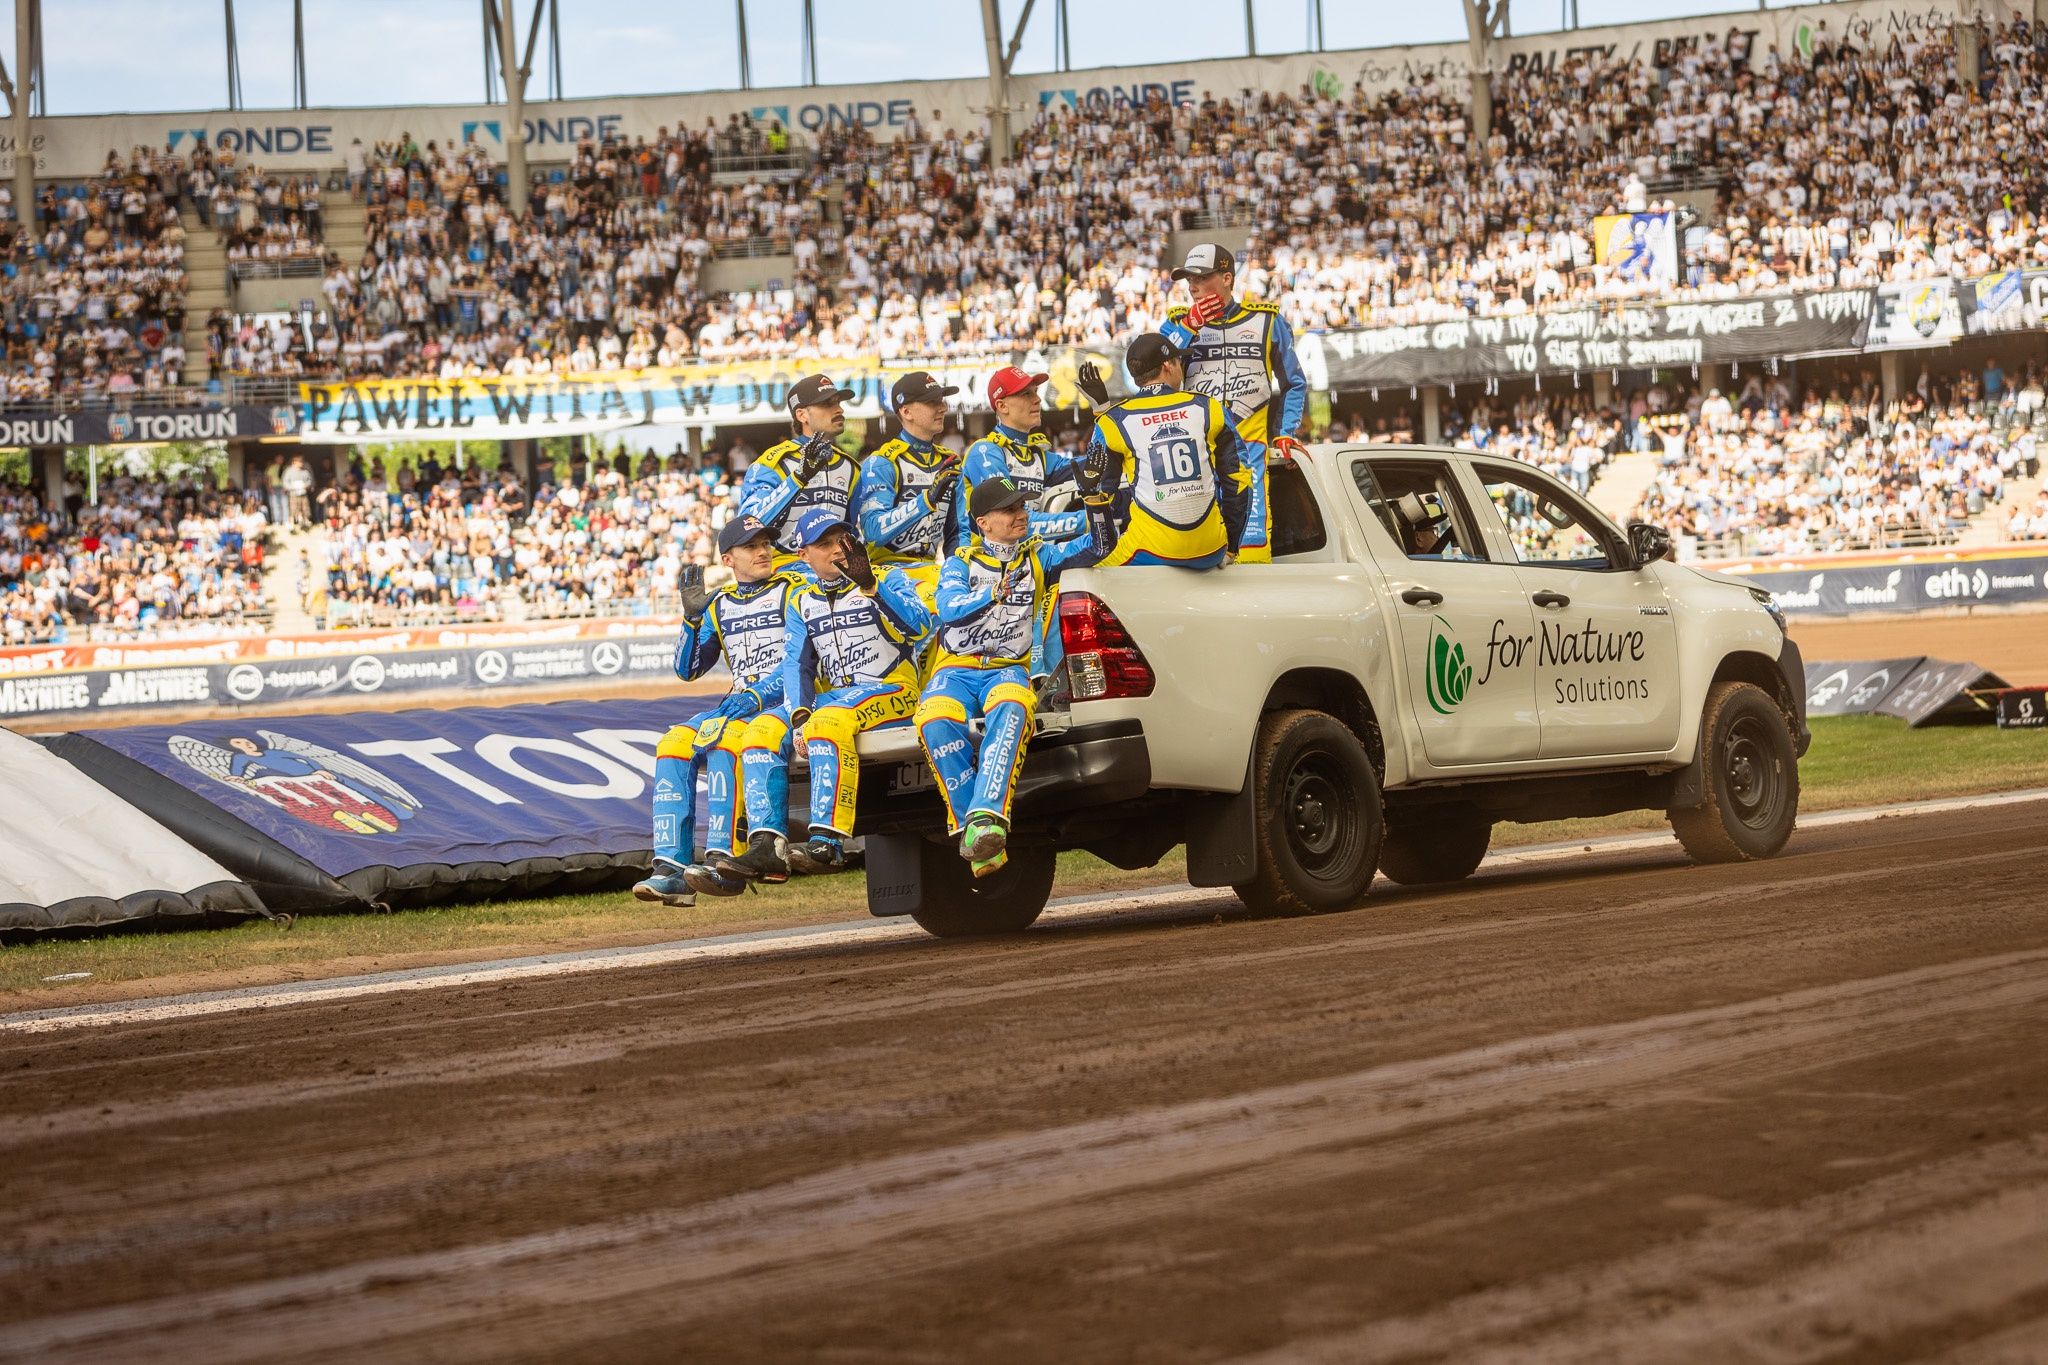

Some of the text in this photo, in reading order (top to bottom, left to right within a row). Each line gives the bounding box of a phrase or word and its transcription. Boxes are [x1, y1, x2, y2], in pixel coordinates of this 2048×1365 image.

[1085, 81, 1196, 110] ONDE
[799, 101, 914, 128] ONDE
[216, 126, 332, 154] ONDE
[135, 407, 238, 440] TORUŃ
[1142, 411, 1189, 426] DEREK
[1155, 442, 1194, 480] 16
[1031, 516, 1077, 534] TMC
[1925, 567, 1969, 598] eth
[1478, 618, 1645, 686] for Nature
[1555, 676, 1649, 704] Solutions
[865, 701, 885, 720] FSG
[932, 739, 965, 760] APRO
